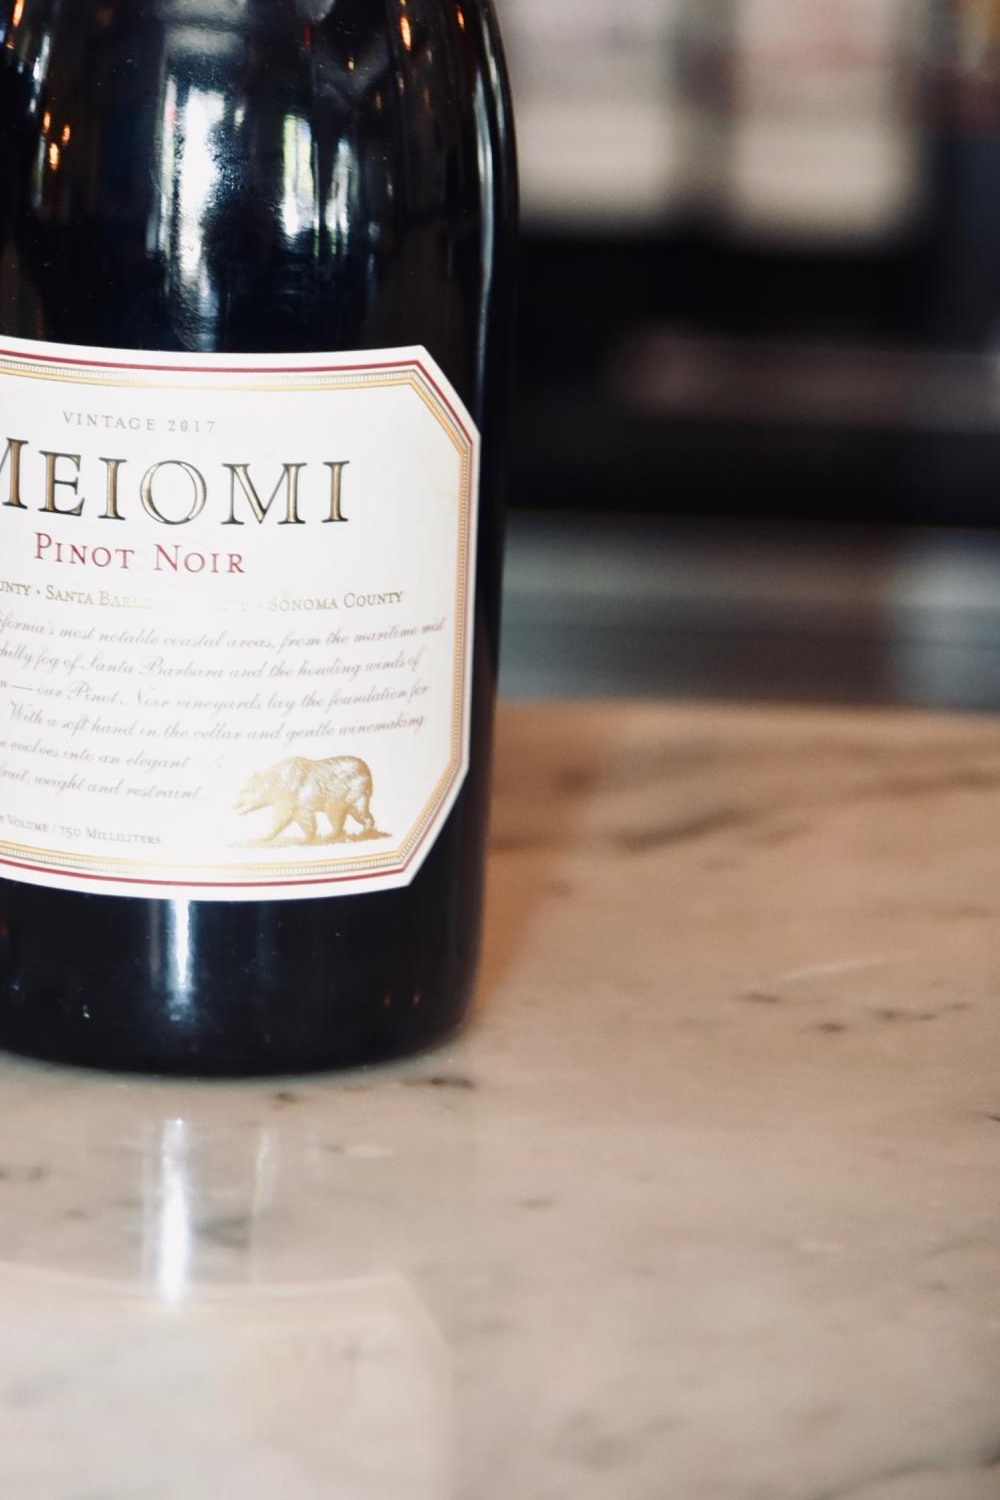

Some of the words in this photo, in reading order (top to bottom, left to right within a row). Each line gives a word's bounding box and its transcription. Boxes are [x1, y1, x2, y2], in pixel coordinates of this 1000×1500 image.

[62, 411, 157, 432] VINTAGE
[167, 419, 217, 434] 2017
[33, 531, 135, 571] PINOT
[153, 544, 246, 574] NOIR
[45, 585, 95, 605] SANTA
[267, 596, 339, 612] SONOMA
[343, 590, 404, 609] COUNTY
[58, 627, 98, 641] most
[98, 627, 160, 645] notable
[162, 629, 227, 647] coastal
[276, 628, 321, 656] from
[326, 627, 350, 645] the
[354, 625, 418, 643] maritime
[33, 646, 60, 675] fog
[63, 651, 86, 676] of
[80, 651, 136, 673] Santa
[138, 654, 224, 677] Barbara
[228, 660, 269, 678] and
[268, 660, 294, 677] the
[297, 656, 362, 683] howling
[364, 649, 405, 673] winds
[407, 645, 426, 673] of
[36, 686, 64, 699] our
[66, 680, 120, 702] Pinot
[120, 685, 170, 708] Noir
[176, 692, 263, 719] vineyards
[266, 691, 297, 718] lay
[300, 688, 326, 709] the
[324, 685, 408, 715] foundation
[407, 676, 430, 705] for
[9, 699, 44, 725] With
[47, 717, 57, 728] a
[61, 714, 90, 738] soft
[90, 715, 139, 737] hand
[140, 726, 159, 739] in
[163, 719, 190, 739] the
[192, 721, 243, 740] cellar
[247, 721, 287, 741] and
[282, 718, 336, 750] gentle
[338, 709, 426, 736] winemaking
[10, 737, 59, 759] evolves
[62, 747, 96, 764] into
[97, 754, 122, 766] an
[125, 748, 193, 776] elegant
[34, 772, 88, 798] weight
[87, 777, 128, 796] and
[7, 813, 49, 834] VOLUME
[59, 825, 82, 839] 750
[85, 827, 163, 846] MILLILITERS
